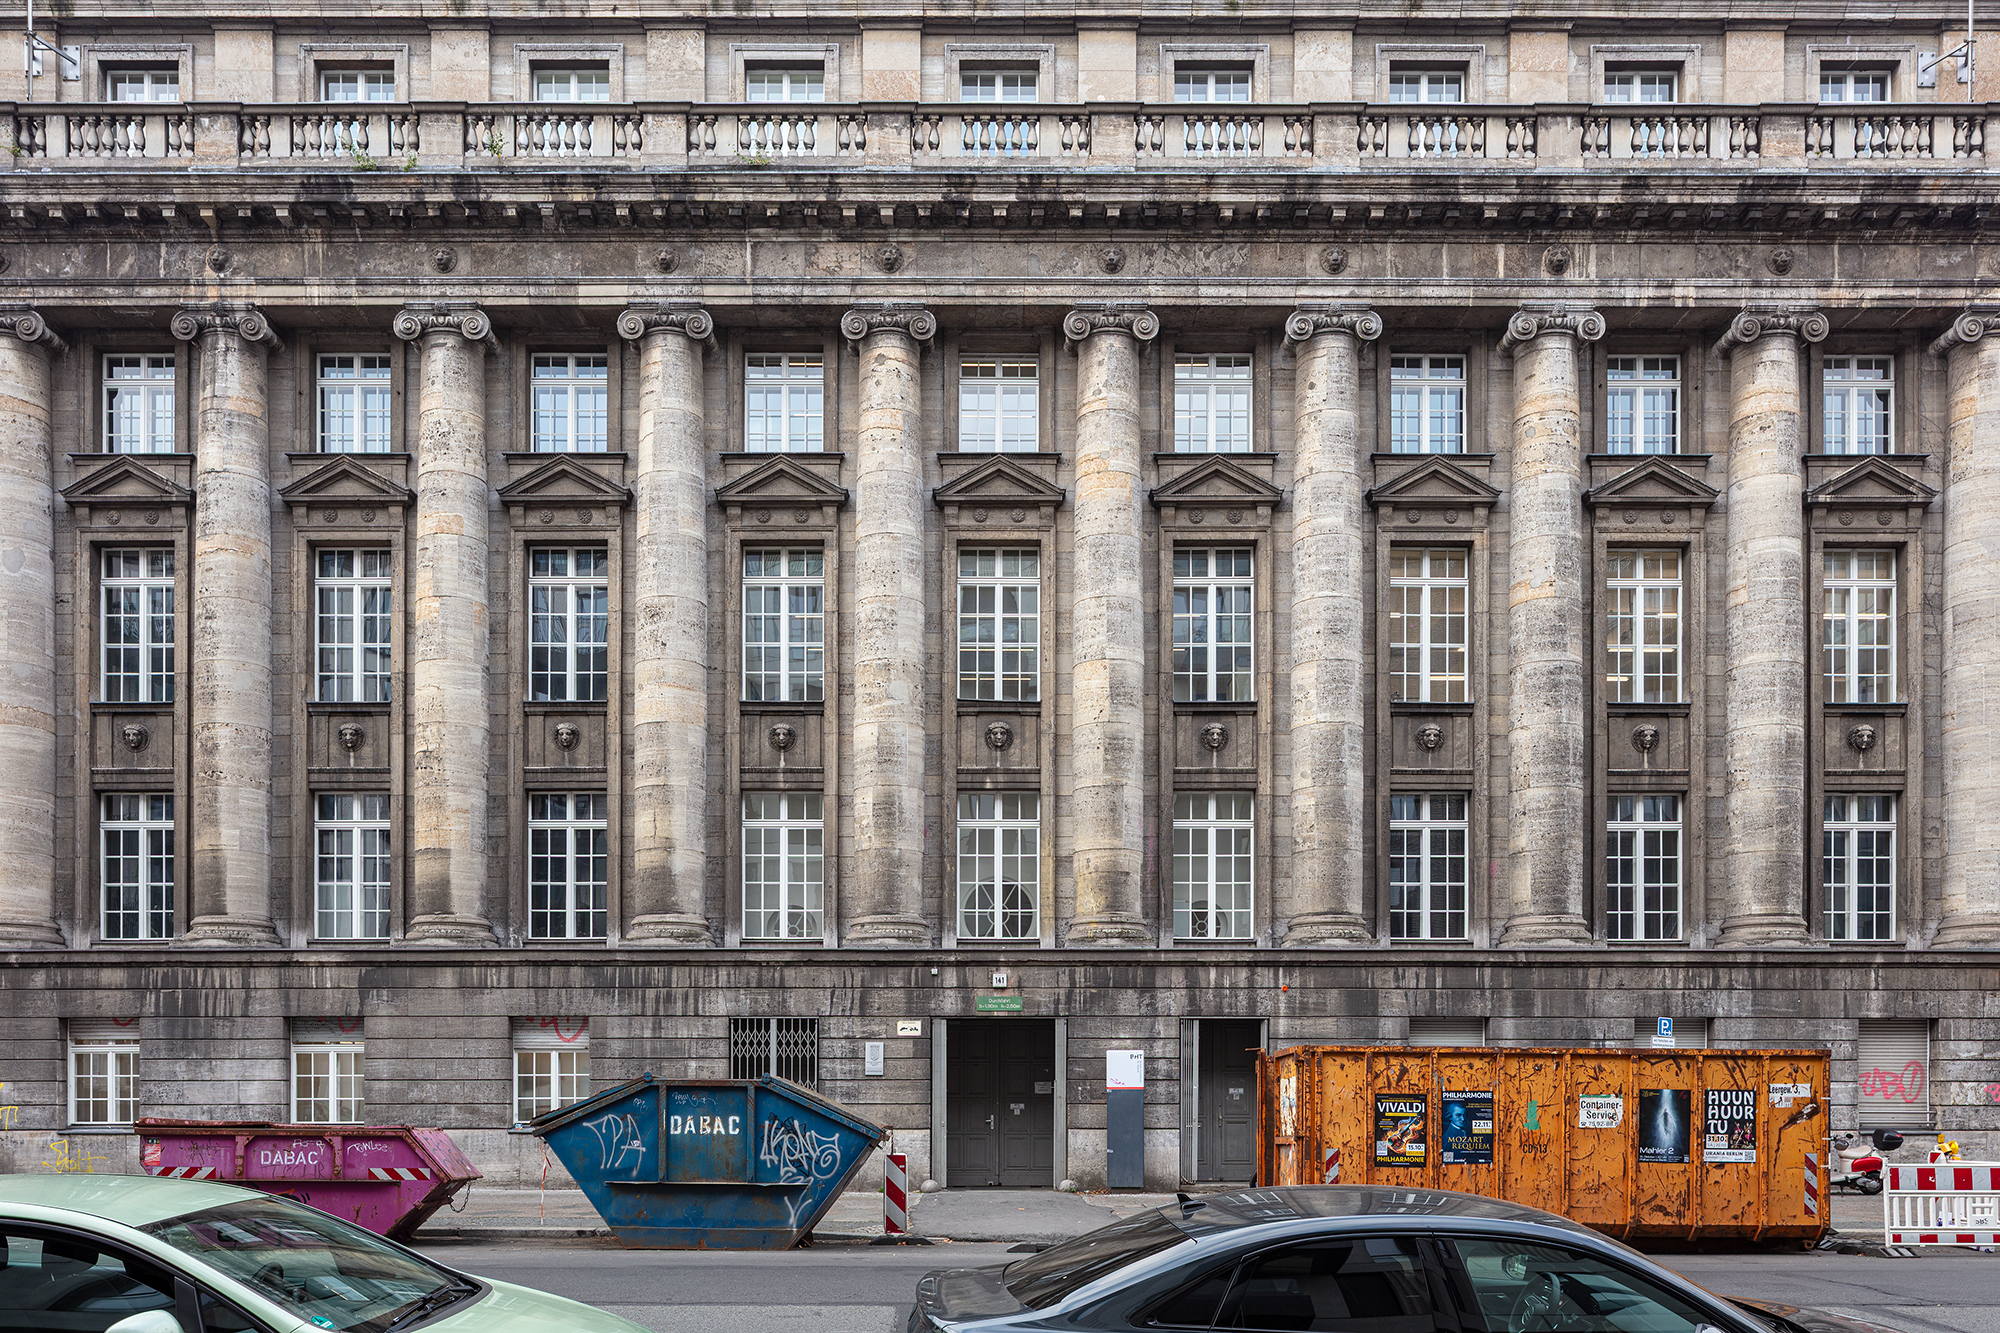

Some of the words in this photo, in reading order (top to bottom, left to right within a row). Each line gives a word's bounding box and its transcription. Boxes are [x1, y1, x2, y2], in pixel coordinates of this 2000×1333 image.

[1661, 1019, 1670, 1034] P
[1580, 1100, 1622, 1110] Container-
[1708, 1090, 1754, 1105] HUUN
[1377, 1102, 1426, 1113] VIVALDI
[1586, 1110, 1617, 1119] Service
[1708, 1105, 1755, 1120] HUUR
[670, 1115, 740, 1135] DABAC
[1706, 1119, 1728, 1134] TU
[1452, 1142, 1490, 1151] REQUIEM
[1639, 1146, 1667, 1154] Mahler
[1667, 1146, 1675, 1155] 2
[260, 1150, 319, 1165] DABAC
